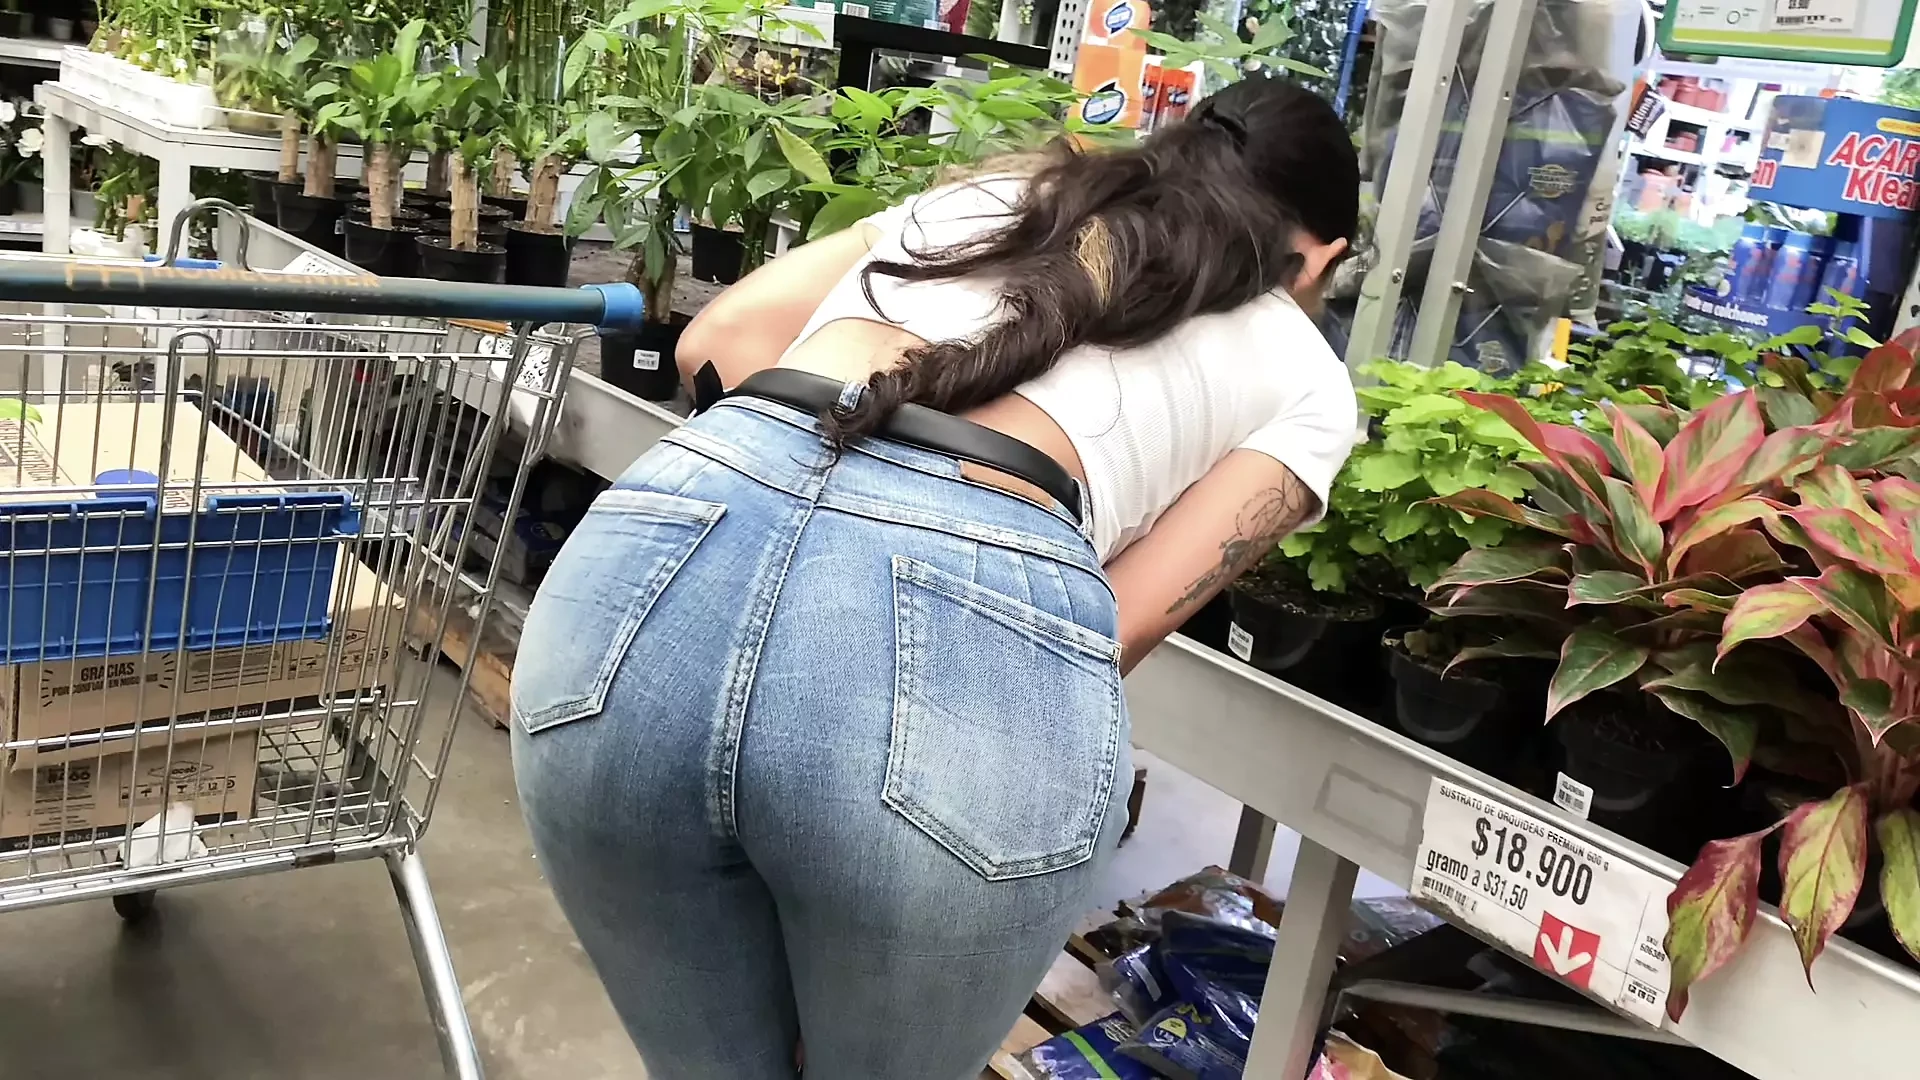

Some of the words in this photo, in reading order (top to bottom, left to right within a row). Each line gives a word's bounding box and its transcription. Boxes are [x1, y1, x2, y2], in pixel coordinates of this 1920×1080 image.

[81, 662, 135, 681] GRACIAS
[1440, 785, 1482, 811] SUSTRATO
[1484, 803, 1496, 816] DE
[1497, 810, 1545, 838] ORQUIDEAS
[1586, 851, 1602, 866] 600
[1426, 849, 1469, 881] gramo
[1471, 869, 1481, 887] a
[1483, 871, 1529, 911] $31,50
[1471, 817, 1593, 906] $18.900
